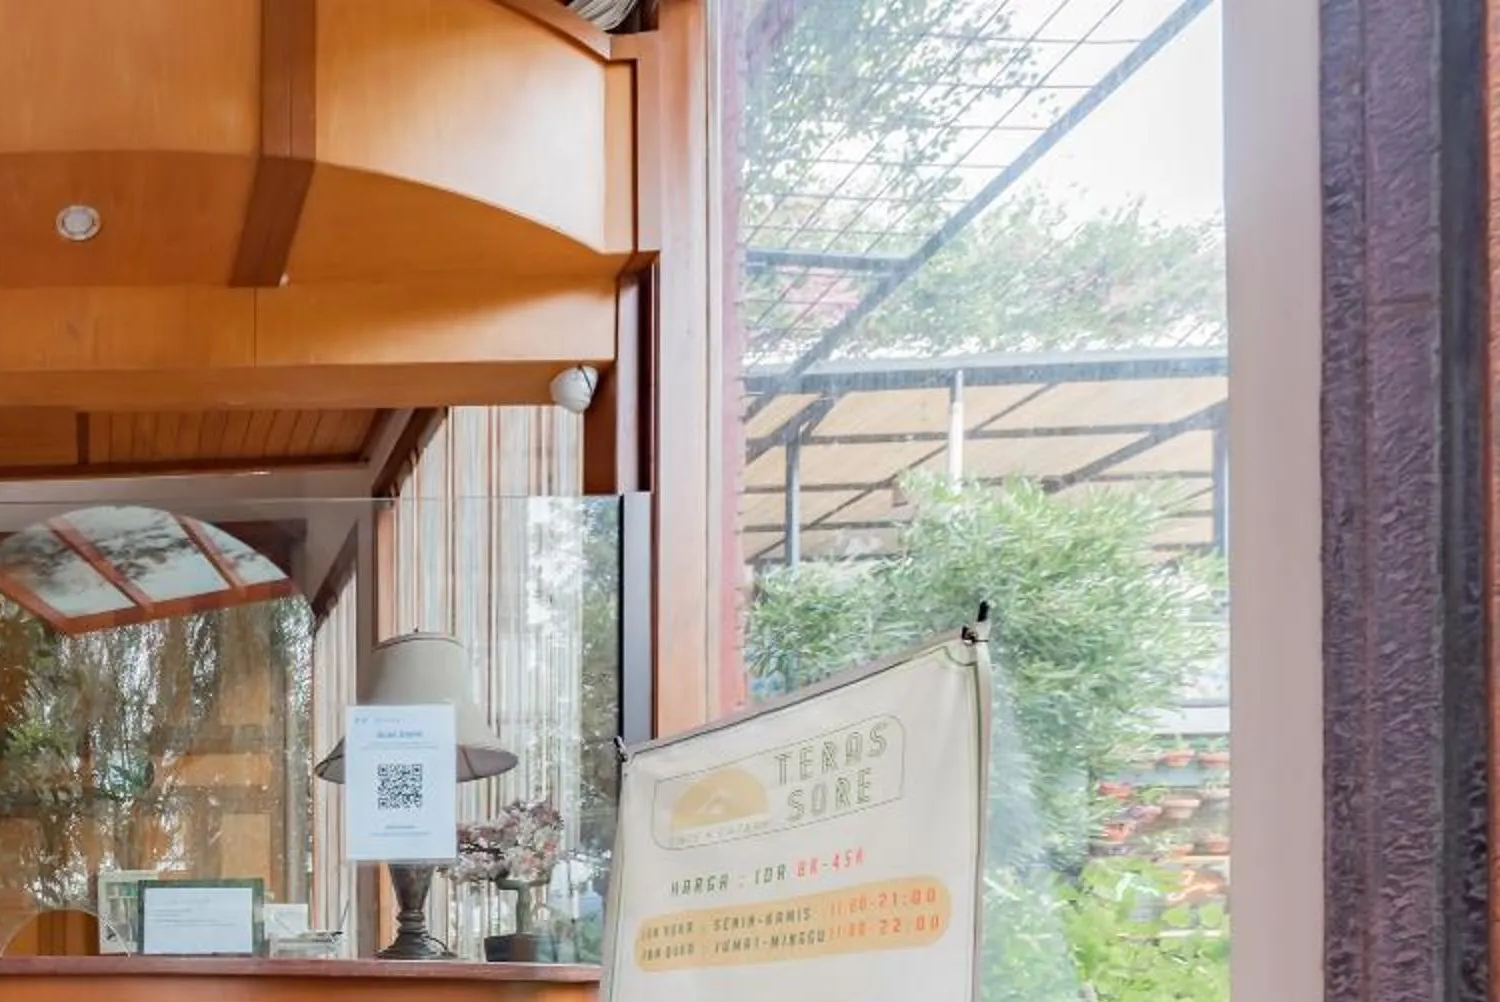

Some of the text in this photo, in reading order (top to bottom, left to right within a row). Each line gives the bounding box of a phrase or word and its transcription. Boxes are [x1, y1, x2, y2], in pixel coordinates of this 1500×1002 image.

[774, 721, 889, 786] TERAS
[786, 766, 872, 822] SORE
[671, 873, 729, 896] HARGA
[754, 862, 786, 885] IDR
